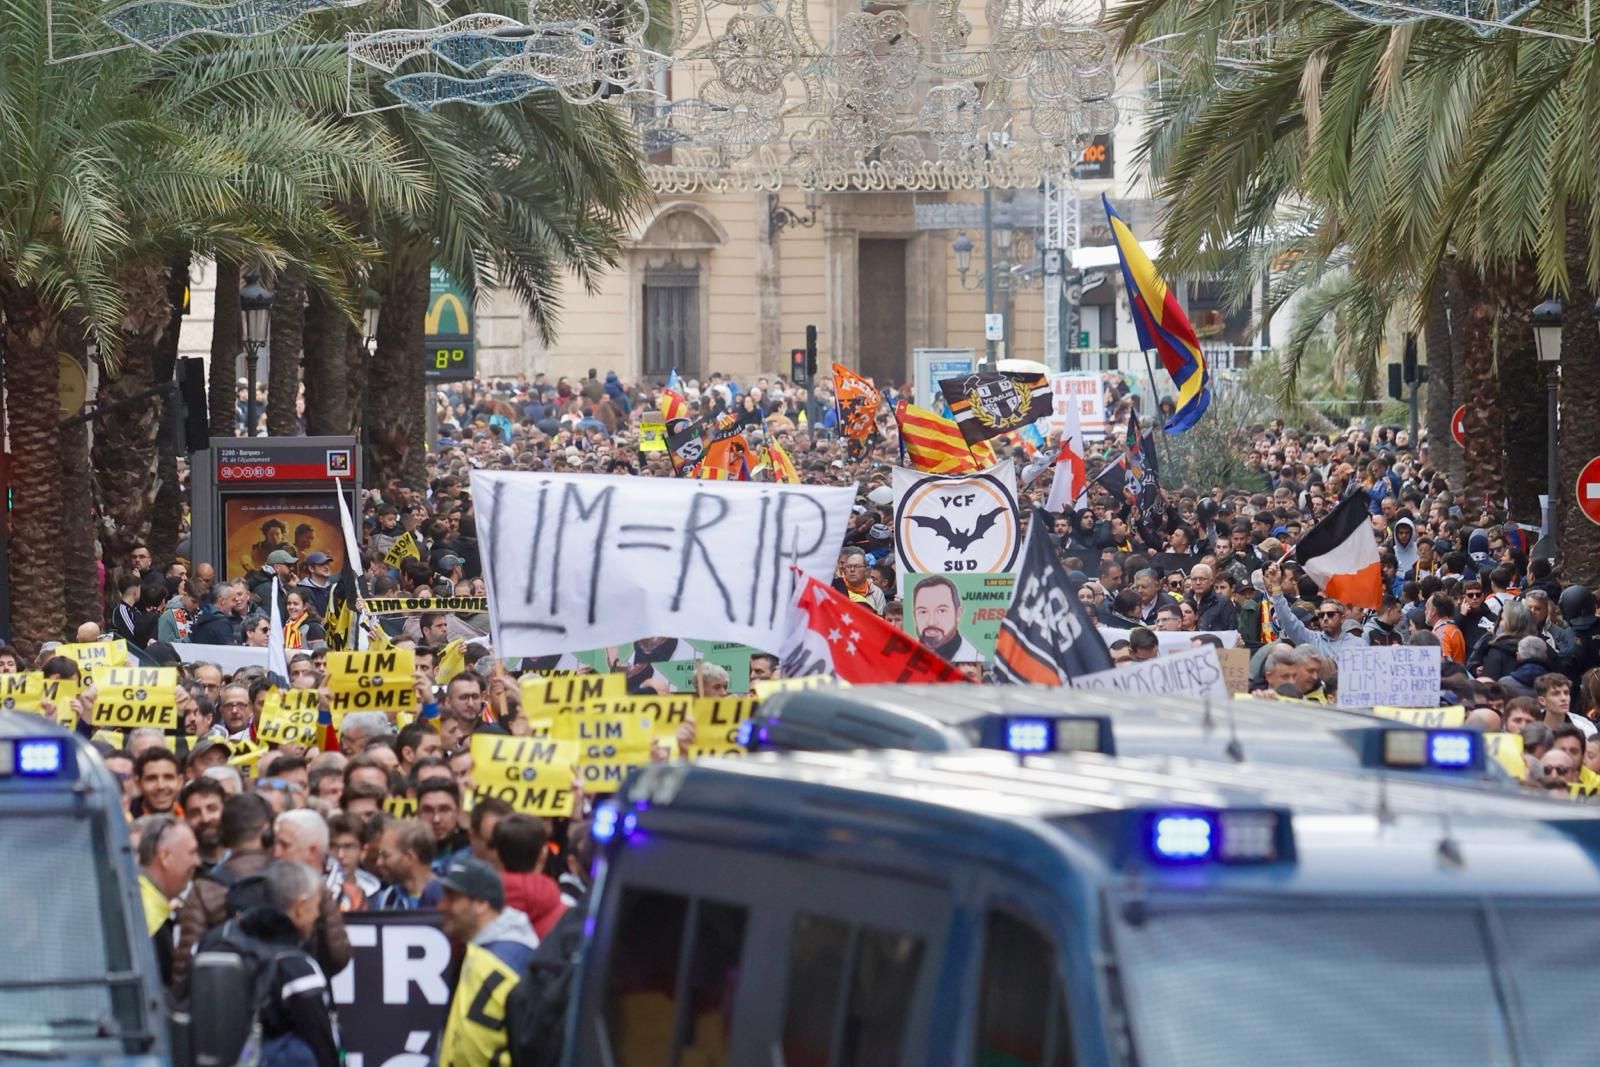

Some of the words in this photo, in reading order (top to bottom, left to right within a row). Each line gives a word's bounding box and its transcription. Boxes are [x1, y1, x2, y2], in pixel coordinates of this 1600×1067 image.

[940, 494, 976, 508] VCF
[944, 559, 978, 572] SUD
[962, 591, 1004, 601] JUANMA
[78, 647, 106, 660] LIM
[344, 653, 396, 673] LIM
[110, 669, 159, 687] LIM
[1391, 678, 1408, 692] GO
[1411, 679, 1438, 692] HOME
[334, 689, 412, 709] HOME
[544, 678, 604, 704] LIM
[95, 703, 174, 724] HOME
[289, 711, 314, 724] GO
[580, 722, 622, 739] LIM
[491, 739, 558, 763] LIM
[473, 785, 570, 809] HOME
